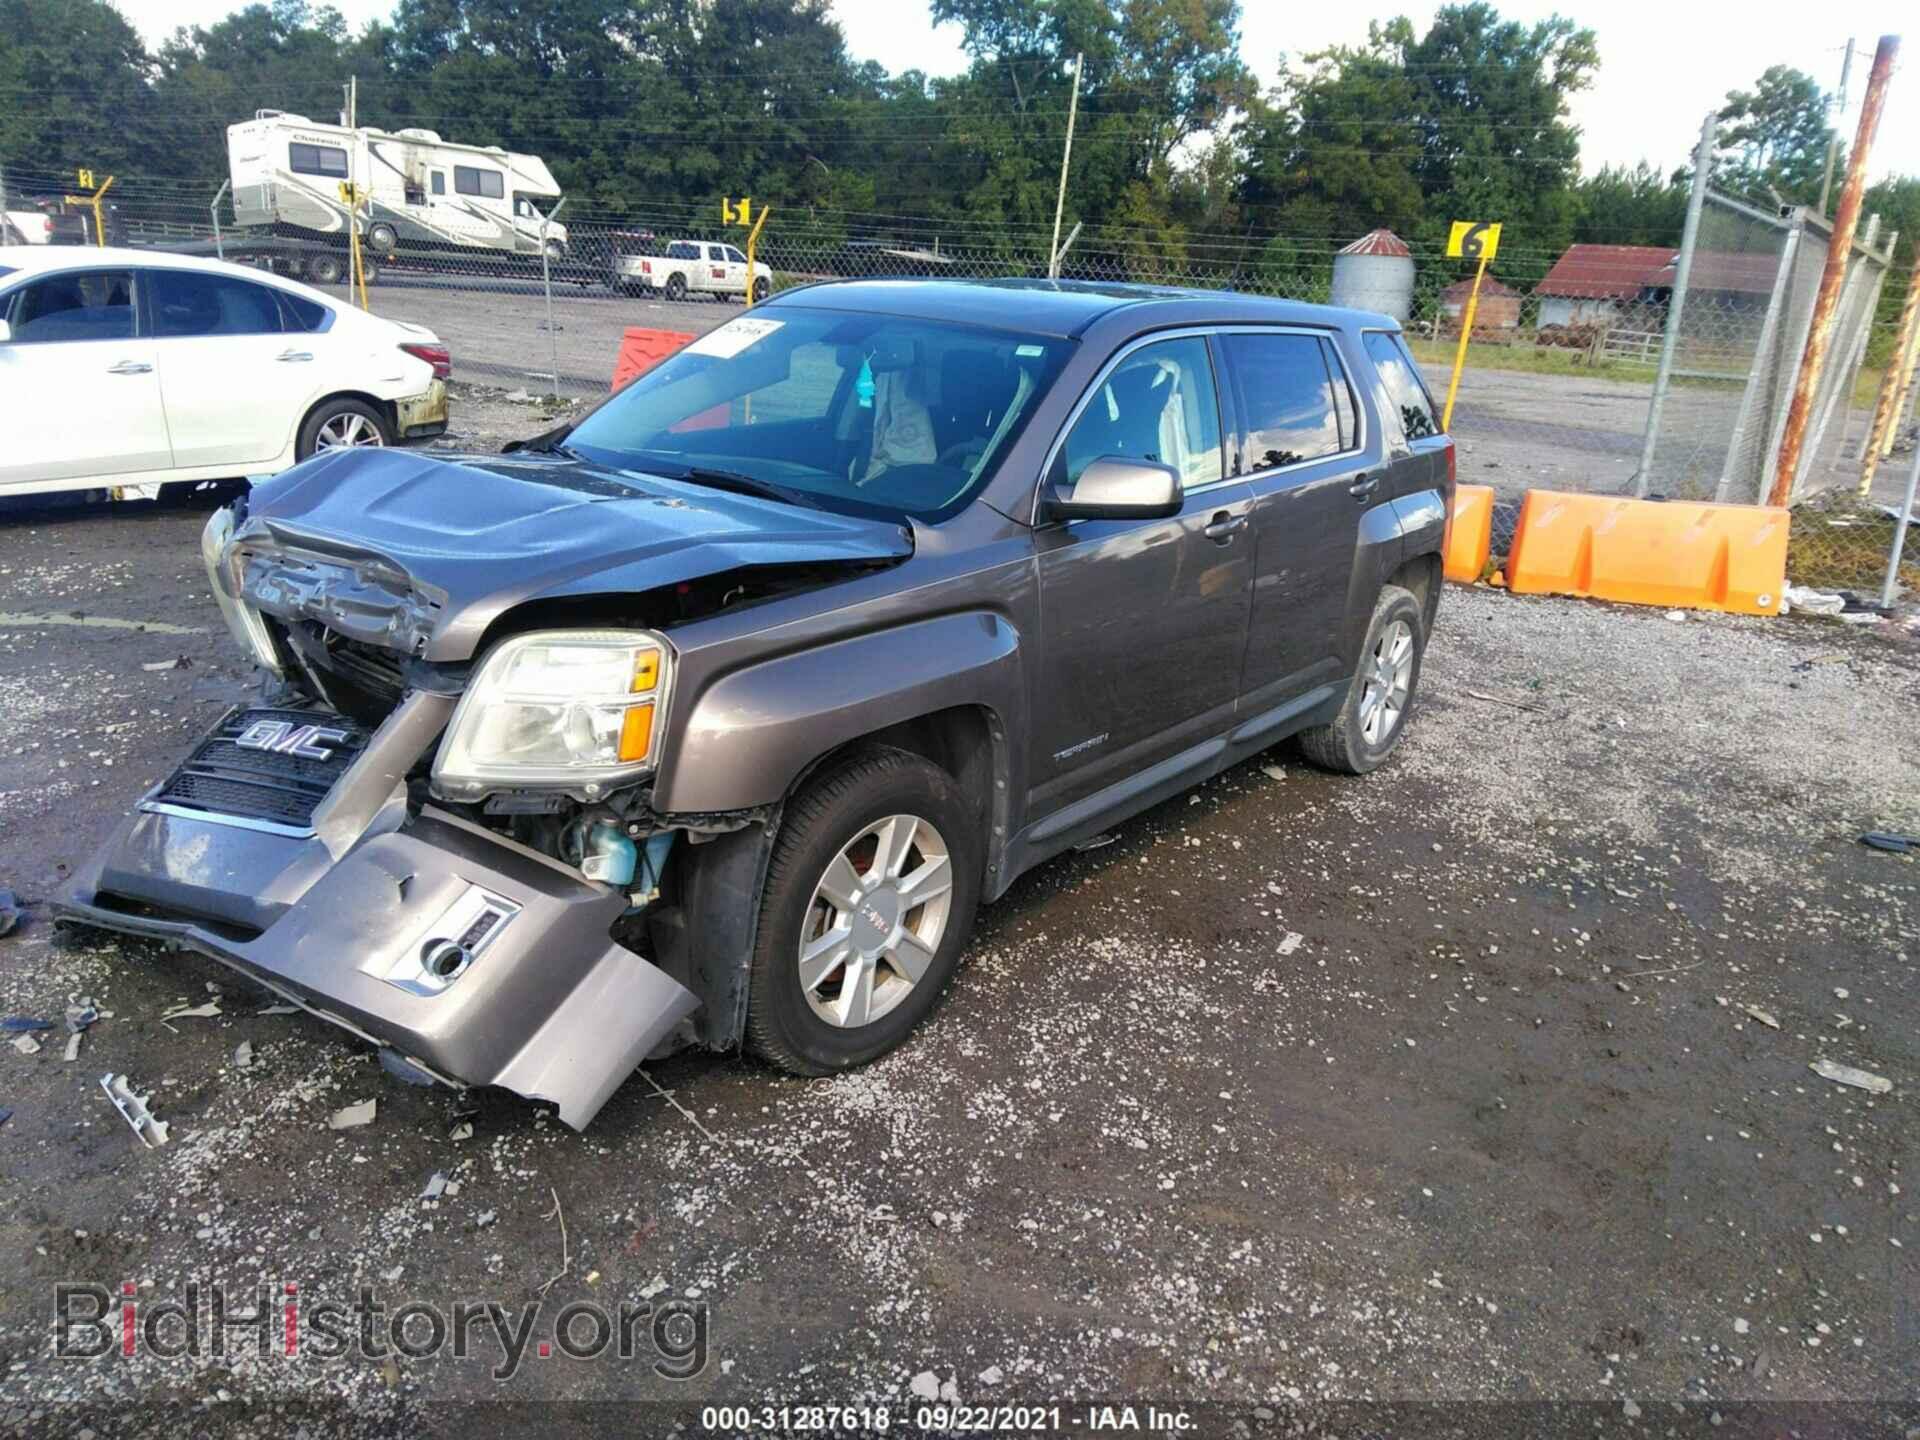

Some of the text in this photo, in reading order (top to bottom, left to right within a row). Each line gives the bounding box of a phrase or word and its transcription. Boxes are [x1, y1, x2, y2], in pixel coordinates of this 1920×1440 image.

[726, 195, 742, 225] 5
[1462, 221, 1490, 259] 6
[236, 719, 349, 761] GMC
